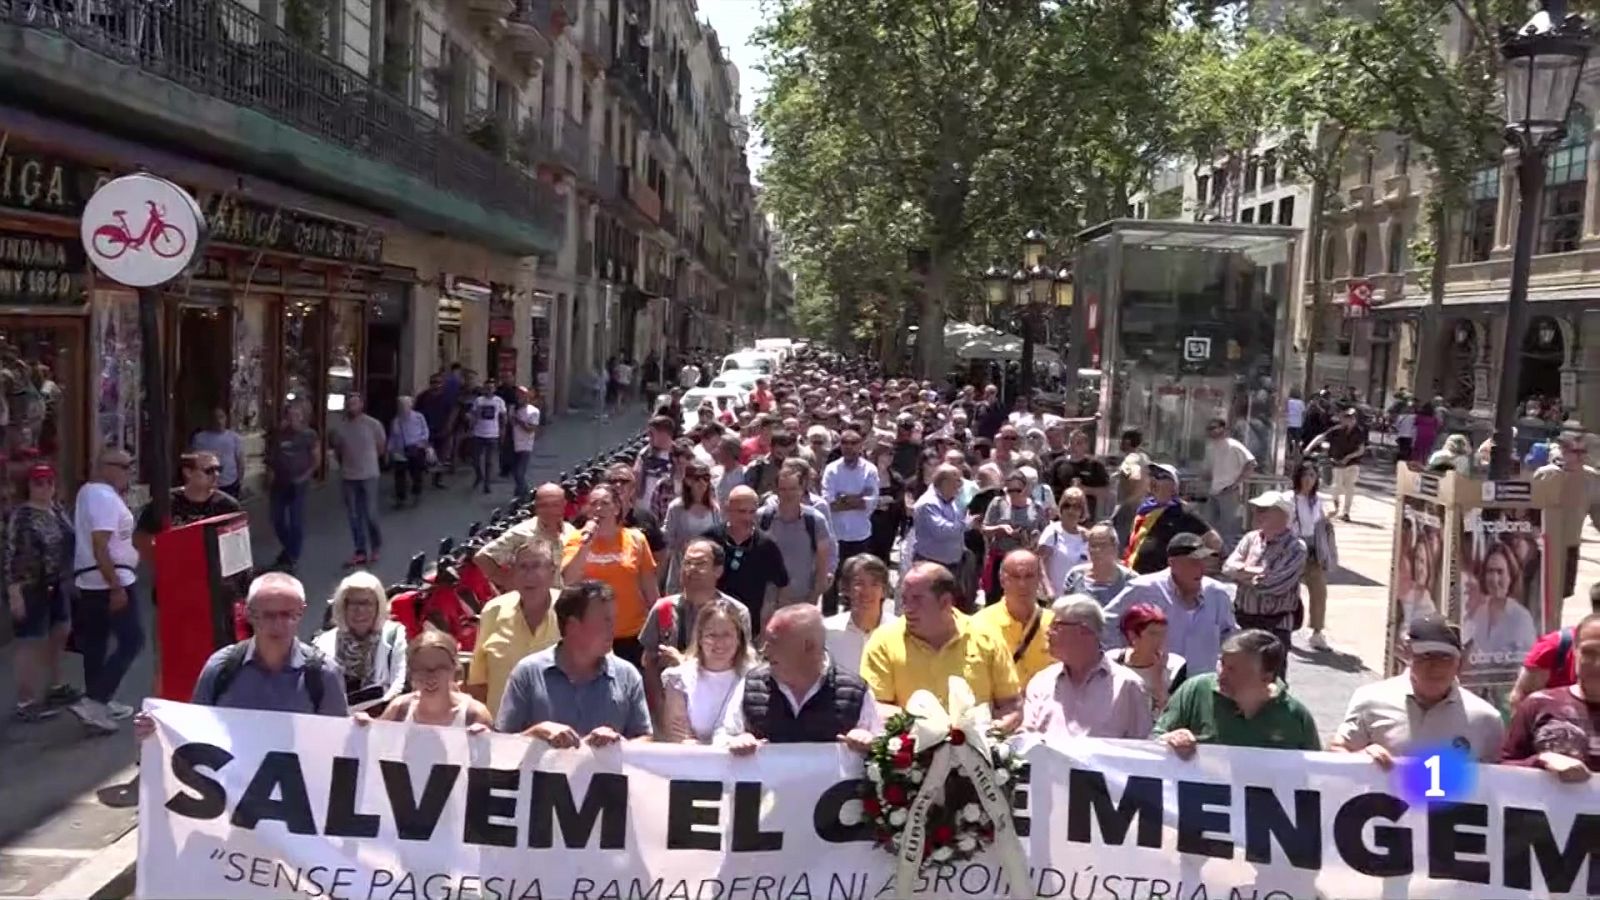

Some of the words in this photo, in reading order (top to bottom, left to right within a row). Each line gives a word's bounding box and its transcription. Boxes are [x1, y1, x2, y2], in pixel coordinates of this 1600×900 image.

[164, 742, 629, 850] SALVEM
[667, 779, 784, 852] EL
[1067, 768, 1600, 896] MENGEM
